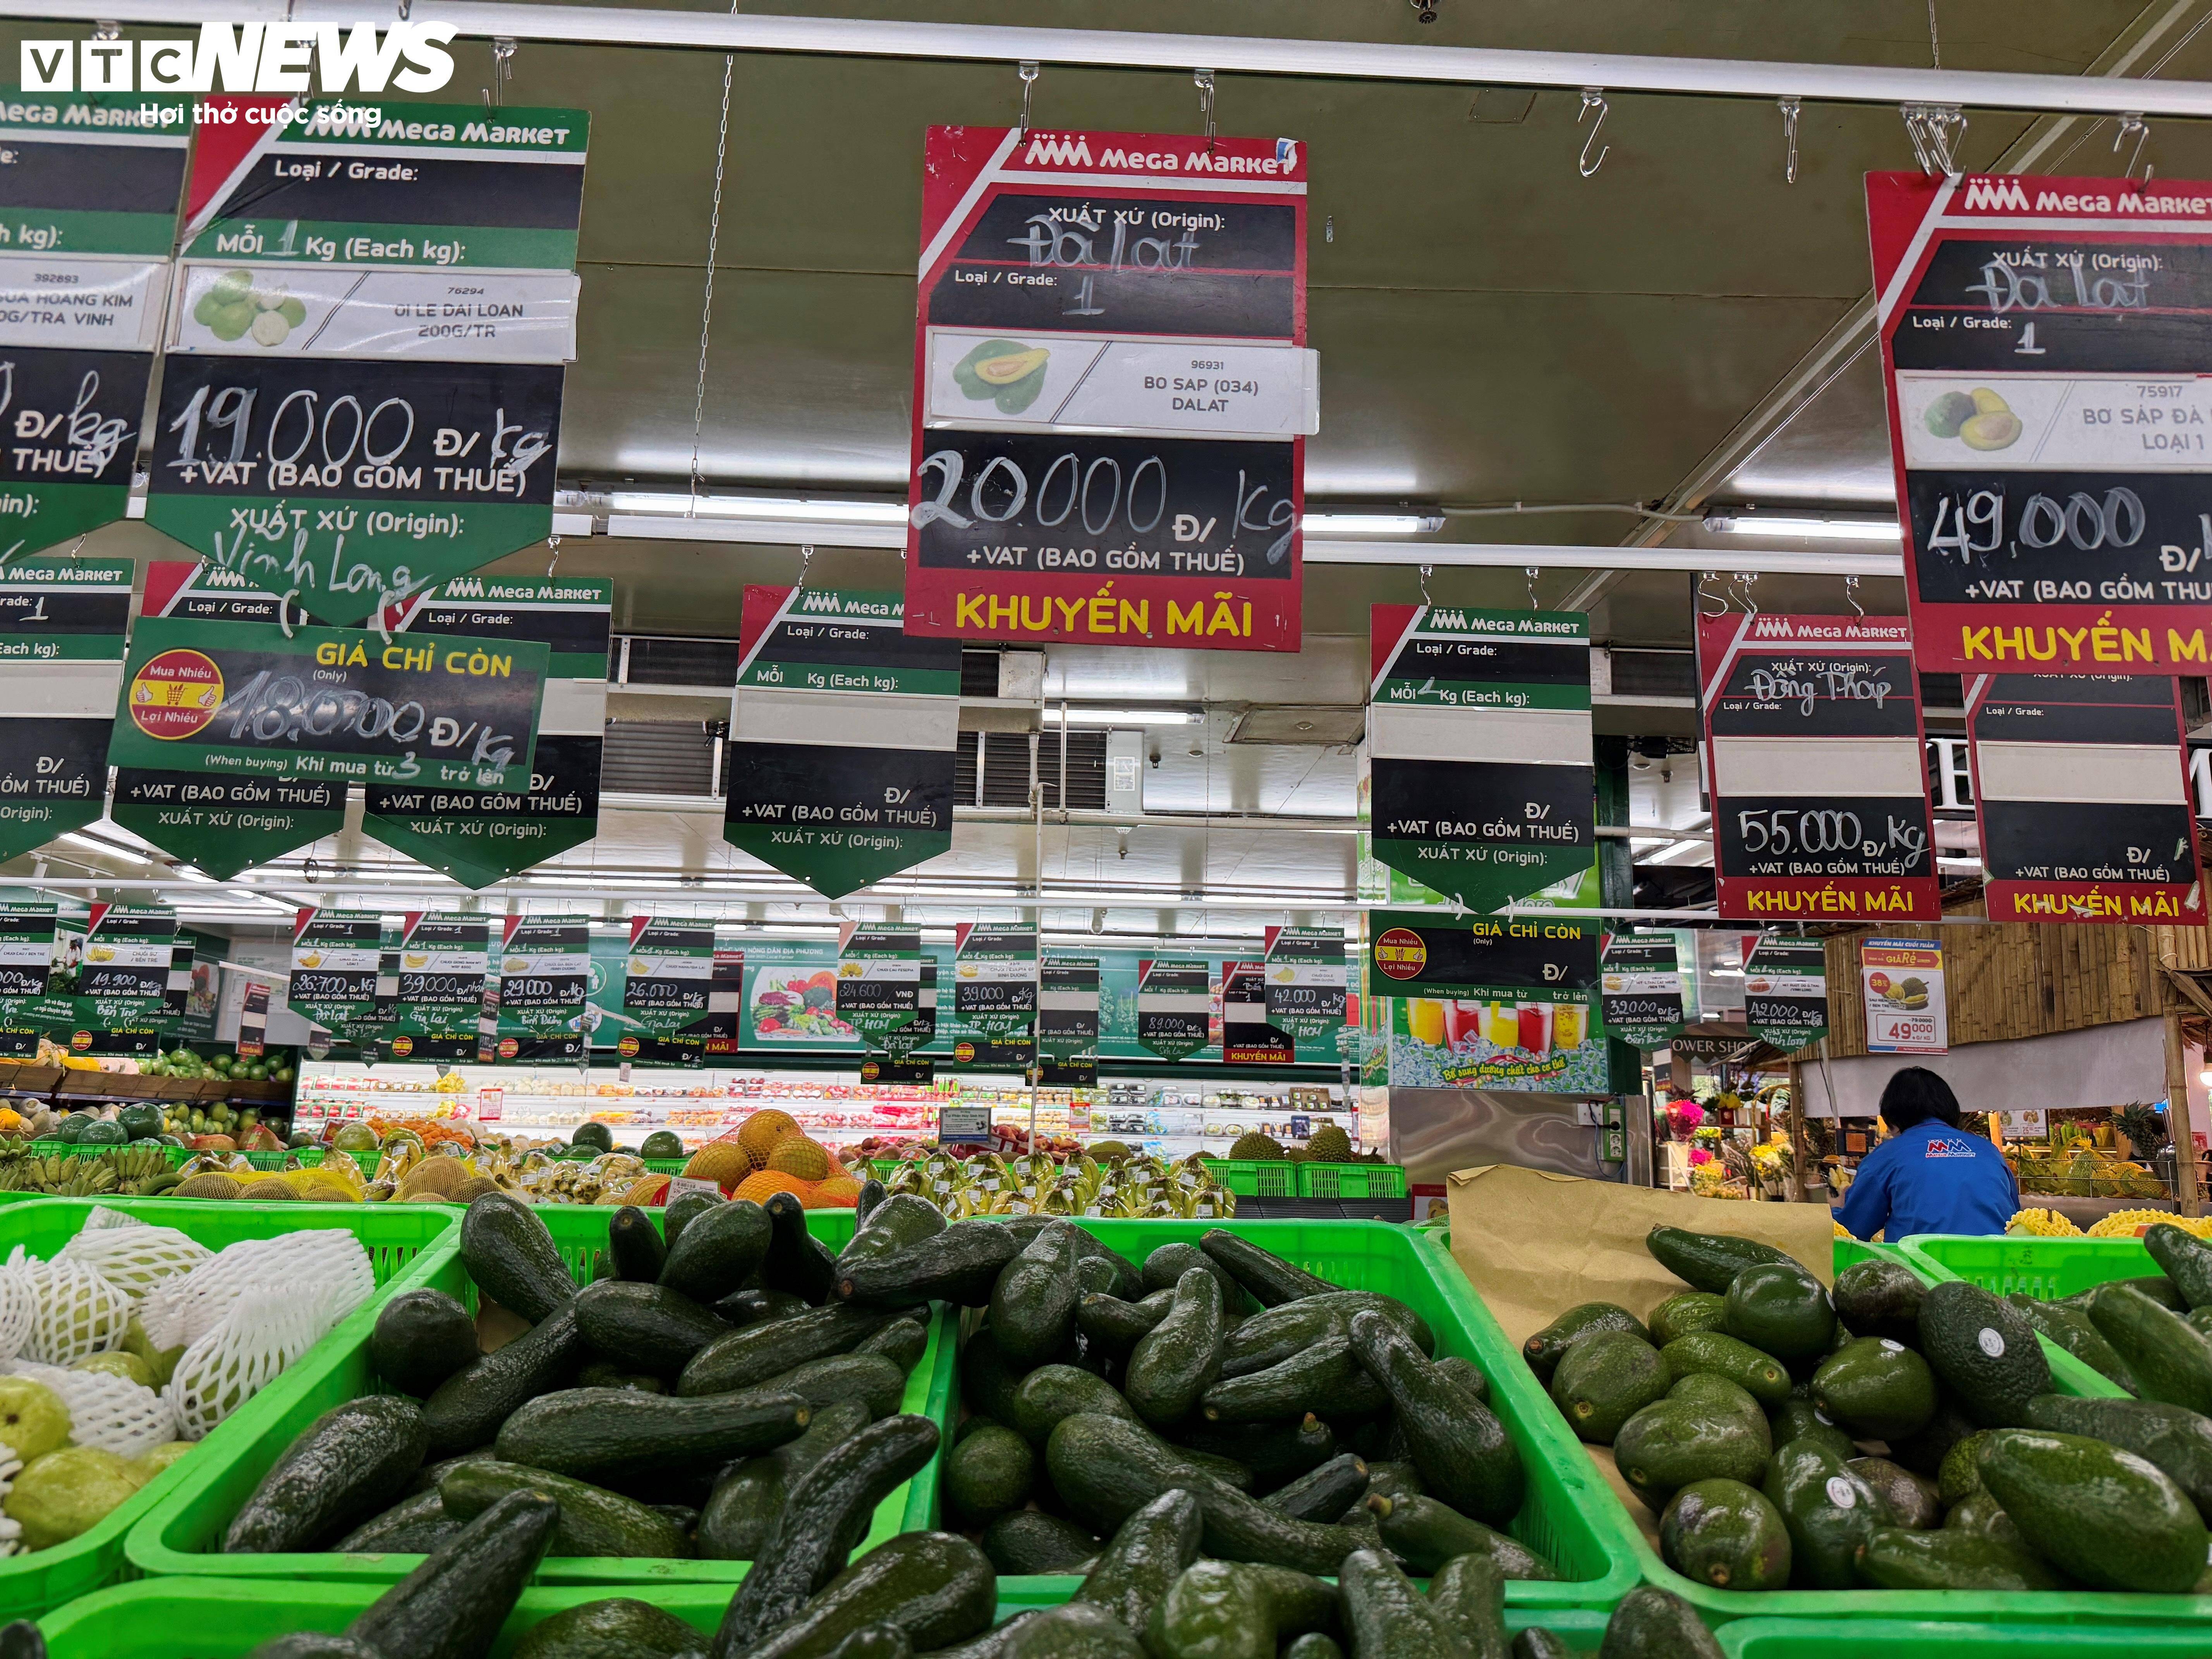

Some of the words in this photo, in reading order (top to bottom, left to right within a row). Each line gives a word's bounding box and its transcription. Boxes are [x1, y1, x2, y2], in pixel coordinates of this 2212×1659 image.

[275, 160, 321, 181] Loại
[349, 162, 419, 181] Grade:
[1049, 202, 1106, 224] XUẤT
[1114, 207, 1144, 226] XỨ
[1152, 212, 1225, 231] (Origin):
[218, 224, 263, 254] MỖI
[306, 237, 335, 261] Kg
[345, 238, 414, 260] (Each
[423, 240, 465, 265] kg):
[1993, 246, 2048, 267] XUẤT
[2092, 254, 2163, 273] (Origin):
[34, 273, 79, 283] 392893
[955, 270, 988, 286] Loại
[1008, 272, 1058, 286] Grade:
[102, 294, 133, 307] KIM
[75, 313, 114, 326] VINH
[478, 304, 523, 318] LOAN
[418, 325, 496, 338] 200G/TR
[1913, 316, 1944, 331] Loại
[1963, 317, 2012, 329] Grade:
[1191, 361, 1224, 370] 96931
[1144, 376, 1167, 390] BO
[1173, 378, 1208, 391] SAP
[1214, 380, 1259, 395] (034)
[2137, 385, 2183, 398] 75917
[1172, 398, 1229, 412] DALAT
[2142, 433, 2190, 453] LOẠI
[2195, 434, 2204, 450] 1
[180, 462, 257, 485] +VAT
[230, 500, 307, 530] XUẤT
[316, 506, 357, 531] XỨ
[367, 511, 464, 538] (Origin):
[967, 546, 1028, 565] +VAT
[1037, 547, 1096, 570] (BAO
[1106, 541, 1160, 570] GỒM
[1169, 544, 1244, 575] THUẾ)
[1966, 580, 2024, 599] +VAT
[2033, 580, 2092, 602] (BAO
[2100, 572, 2153, 600] GỒM
[956, 580, 1150, 633] KHUYẾN
[1167, 591, 1252, 637] MÃI
[1962, 610, 2153, 662] KHUYẾN
[315, 639, 368, 668] GIÁ
[383, 642, 433, 672] CHỈ
[446, 650, 512, 678] CÒN
[150, 665, 175, 677] Mua
[178, 666, 212, 680] Nhiều
[313, 669, 347, 683] (Only)
[141, 708, 161, 724] Lợi
[165, 710, 198, 725] Nhiều
[206, 754, 242, 768] (When
[245, 756, 288, 771] buying)
[295, 756, 324, 772] Khi
[330, 760, 367, 775] mua
[374, 761, 393, 776] từ
[441, 765, 471, 781] trở
[1418, 842, 1461, 860] XUẤT
[1466, 846, 1489, 860] XỨ
[1493, 850, 1548, 866] (Origin):
[1749, 862, 1784, 874] +VAT
[1788, 862, 1823, 875] (BAO
[1827, 859, 1858, 874] GỒM
[1862, 860, 1905, 876] THUẾ)
[1747, 881, 1856, 912] KHUYẾN
[1865, 886, 1913, 912] MÃI
[2131, 890, 2180, 917] MÃI
[1473, 920, 1503, 937] GIÁ
[1510, 921, 1538, 938] CHỈ
[1544, 923, 1581, 939] CÒN
[1424, 988, 1445, 996] (When
[1446, 988, 1470, 997] buying)
[1889, 1022, 1911, 1040] 49
[1912, 1024, 1933, 1033] 000
[712, 1042, 729, 1051] MÃI
[1231, 1050, 1267, 1061] KHUYẾN
[1269, 1052, 1286, 1061] MÃI
[1458, 1067, 1477, 1077] sung
[1506, 1064, 1525, 1075] chất
[1527, 1063, 1540, 1073] cho
